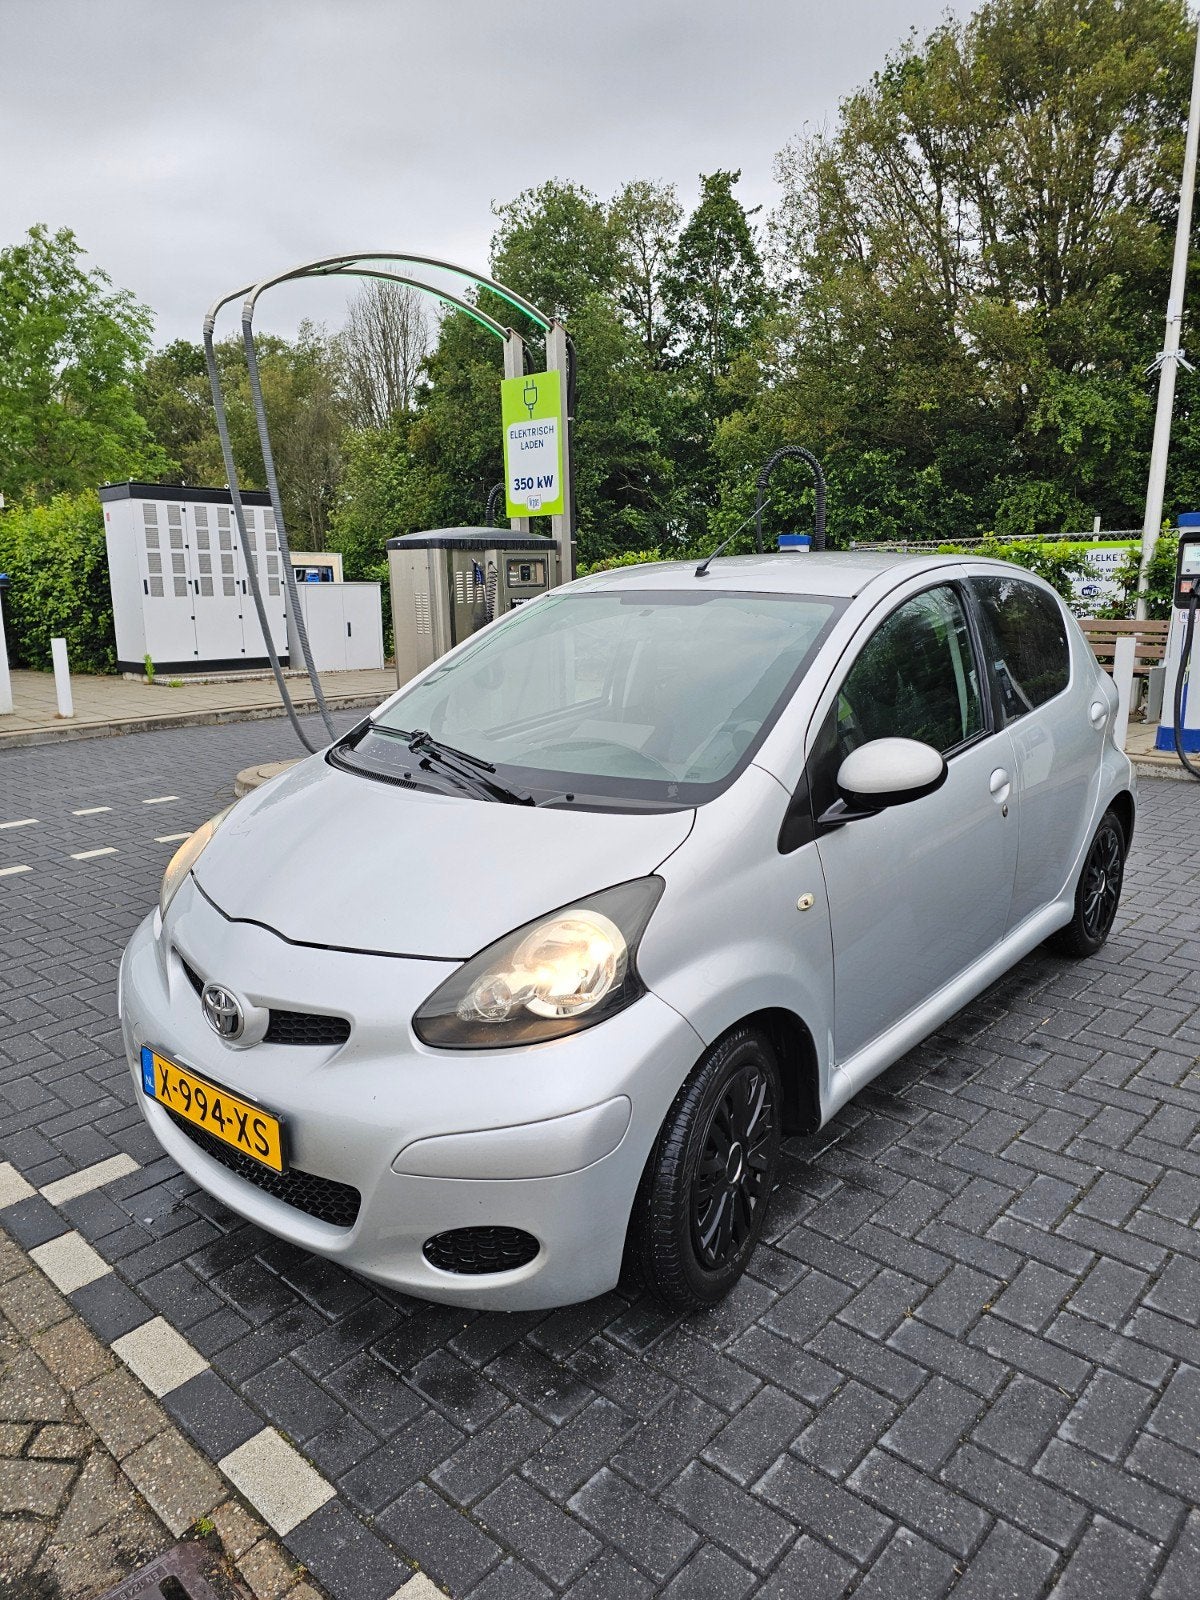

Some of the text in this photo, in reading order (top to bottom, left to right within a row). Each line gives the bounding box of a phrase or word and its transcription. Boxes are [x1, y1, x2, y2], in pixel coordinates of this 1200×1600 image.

[510, 425, 554, 440] ELEKTRISCH
[520, 439, 544, 450] LADEN
[514, 475, 553, 491] 350 kW
[158, 1063, 270, 1157] X-994-XS
